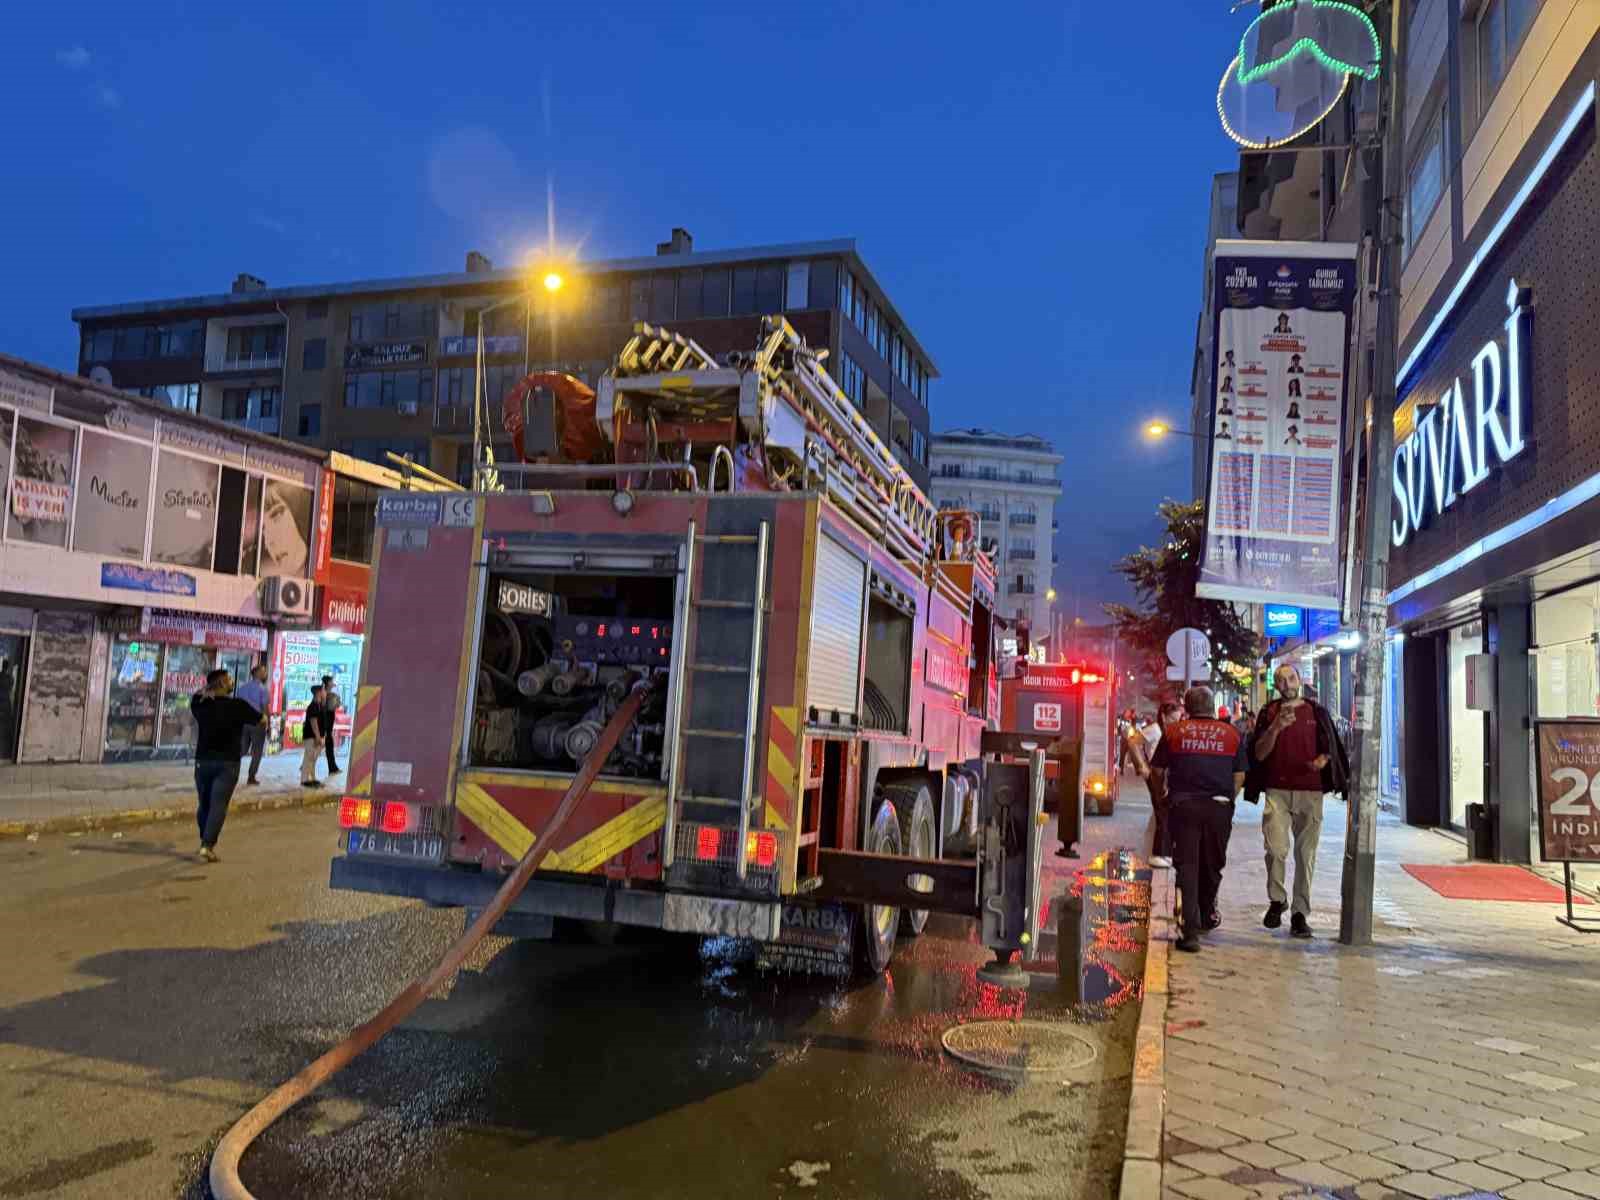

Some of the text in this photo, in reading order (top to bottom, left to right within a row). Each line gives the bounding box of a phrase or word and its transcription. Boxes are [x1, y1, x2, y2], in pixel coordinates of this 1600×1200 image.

[1392, 277, 1525, 547] SÜVARİ
[382, 498, 438, 512] karba
[1038, 706, 1057, 719] 112
